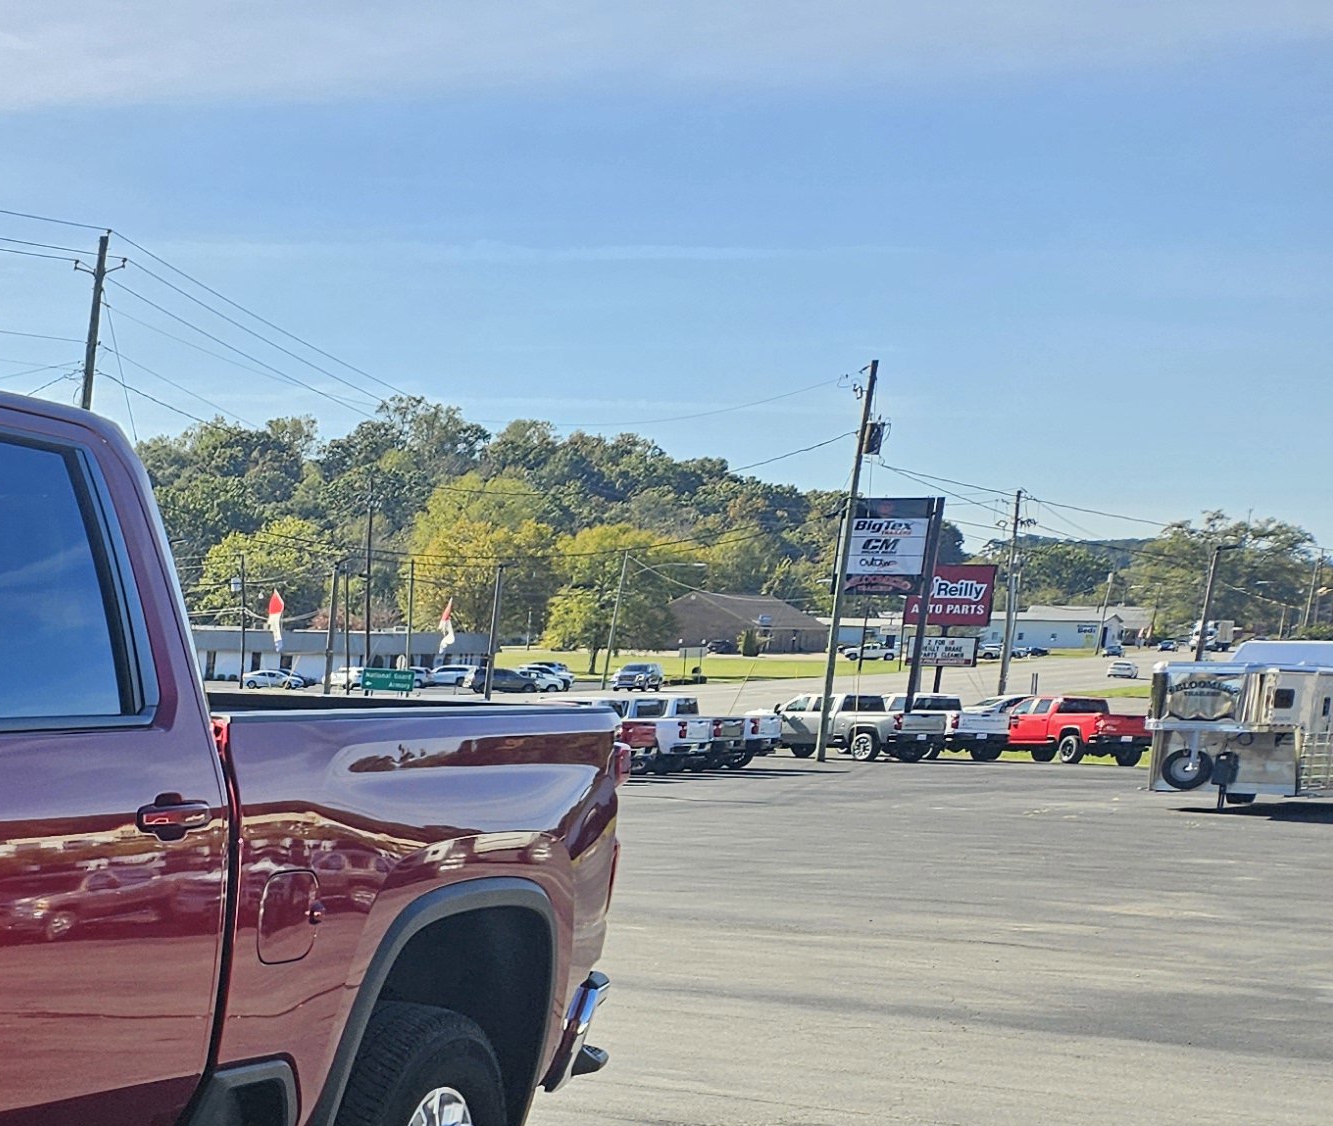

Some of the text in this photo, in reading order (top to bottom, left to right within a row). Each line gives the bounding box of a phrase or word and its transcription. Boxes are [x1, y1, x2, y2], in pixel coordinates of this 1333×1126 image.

[861, 538, 901, 550] CM
[930, 577, 987, 601] 'Reilly
[910, 603, 985, 615] ATO PARTS
